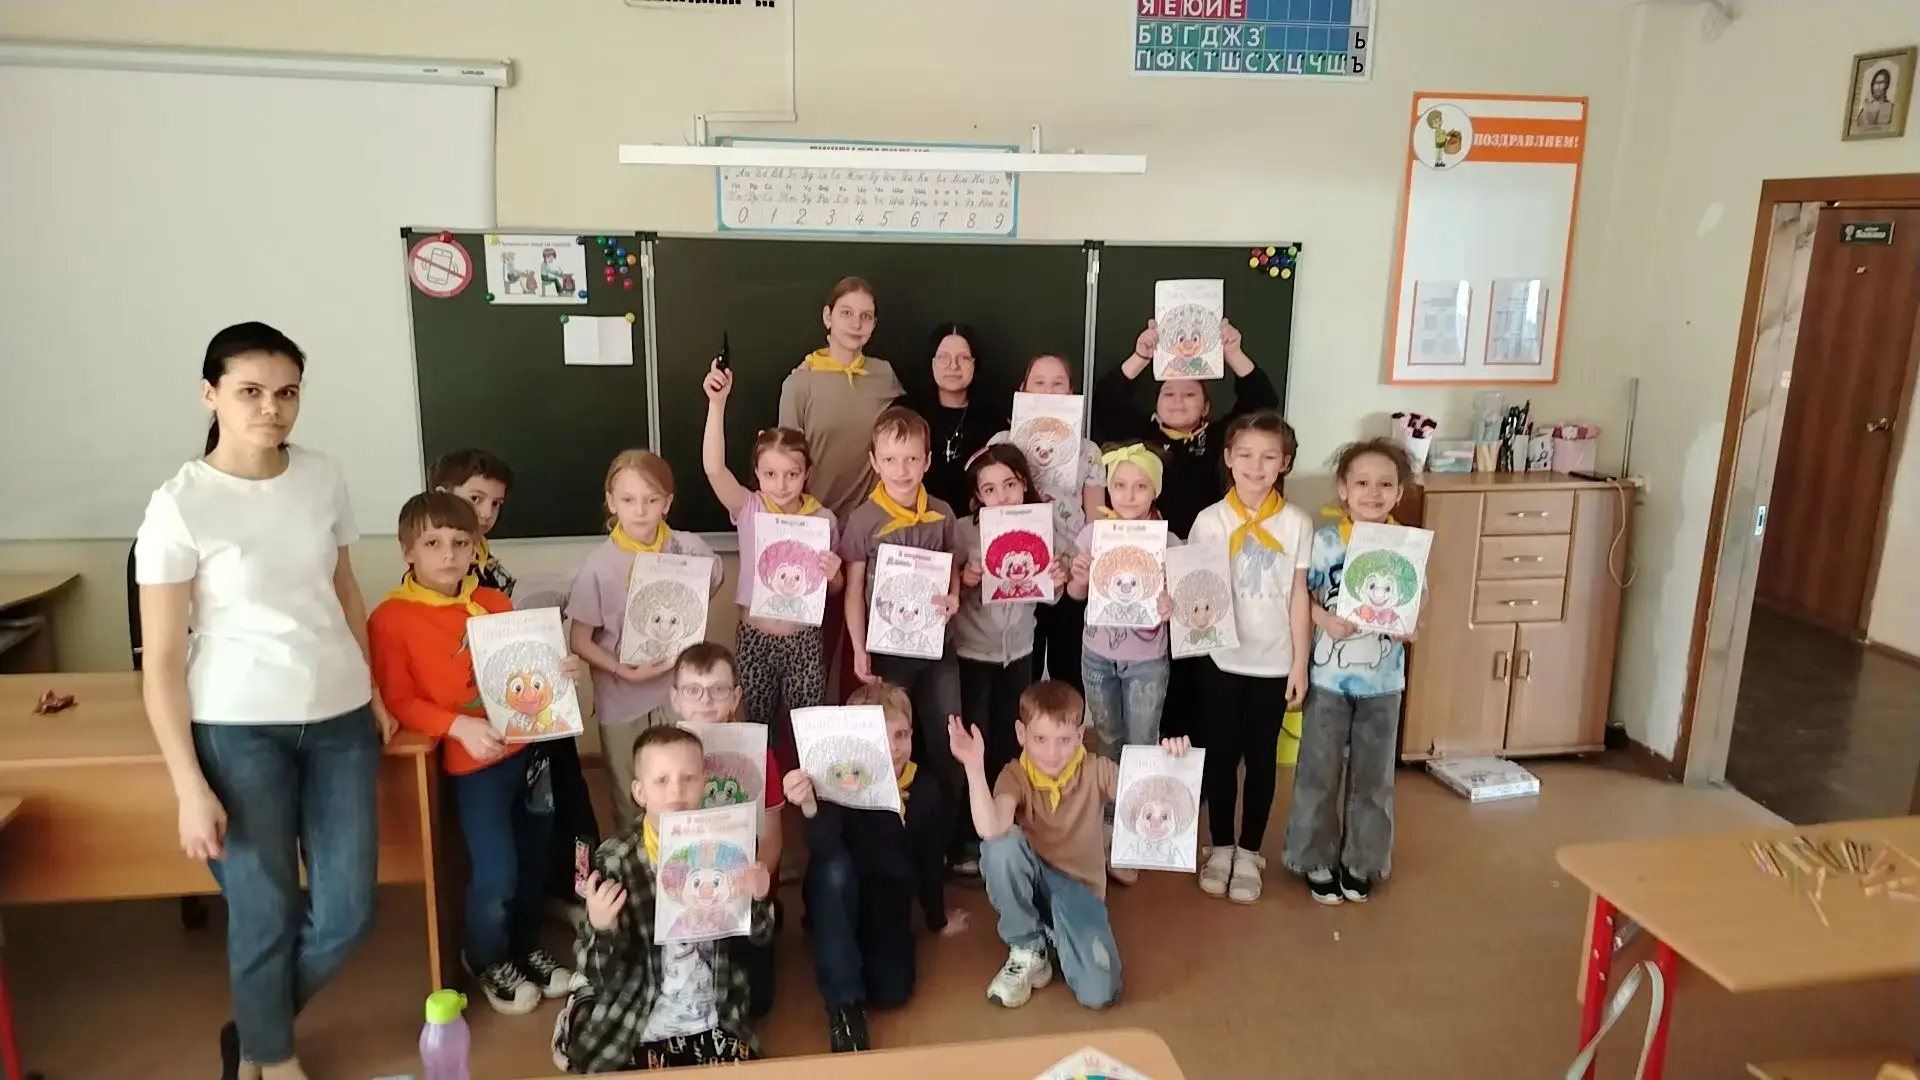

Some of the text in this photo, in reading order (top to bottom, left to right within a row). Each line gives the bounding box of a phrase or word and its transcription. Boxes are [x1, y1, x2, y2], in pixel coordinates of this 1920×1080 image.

[1140, 0, 1154, 15] Я
[1183, 0, 1203, 16] Ю
[1205, 0, 1222, 17] И
[1229, 0, 1242, 17] Е
[1138, 24, 1260, 48] Б В Г Д Ж З
[1136, 49, 1346, 75] П Ф К Т Ш С Х Ц Ч Щ
[1473, 133, 1580, 149] ПОЗДРАВЛЯЕМ!
[738, 206, 1005, 230] 0 1 2 3 4 5 6 7 8 9
